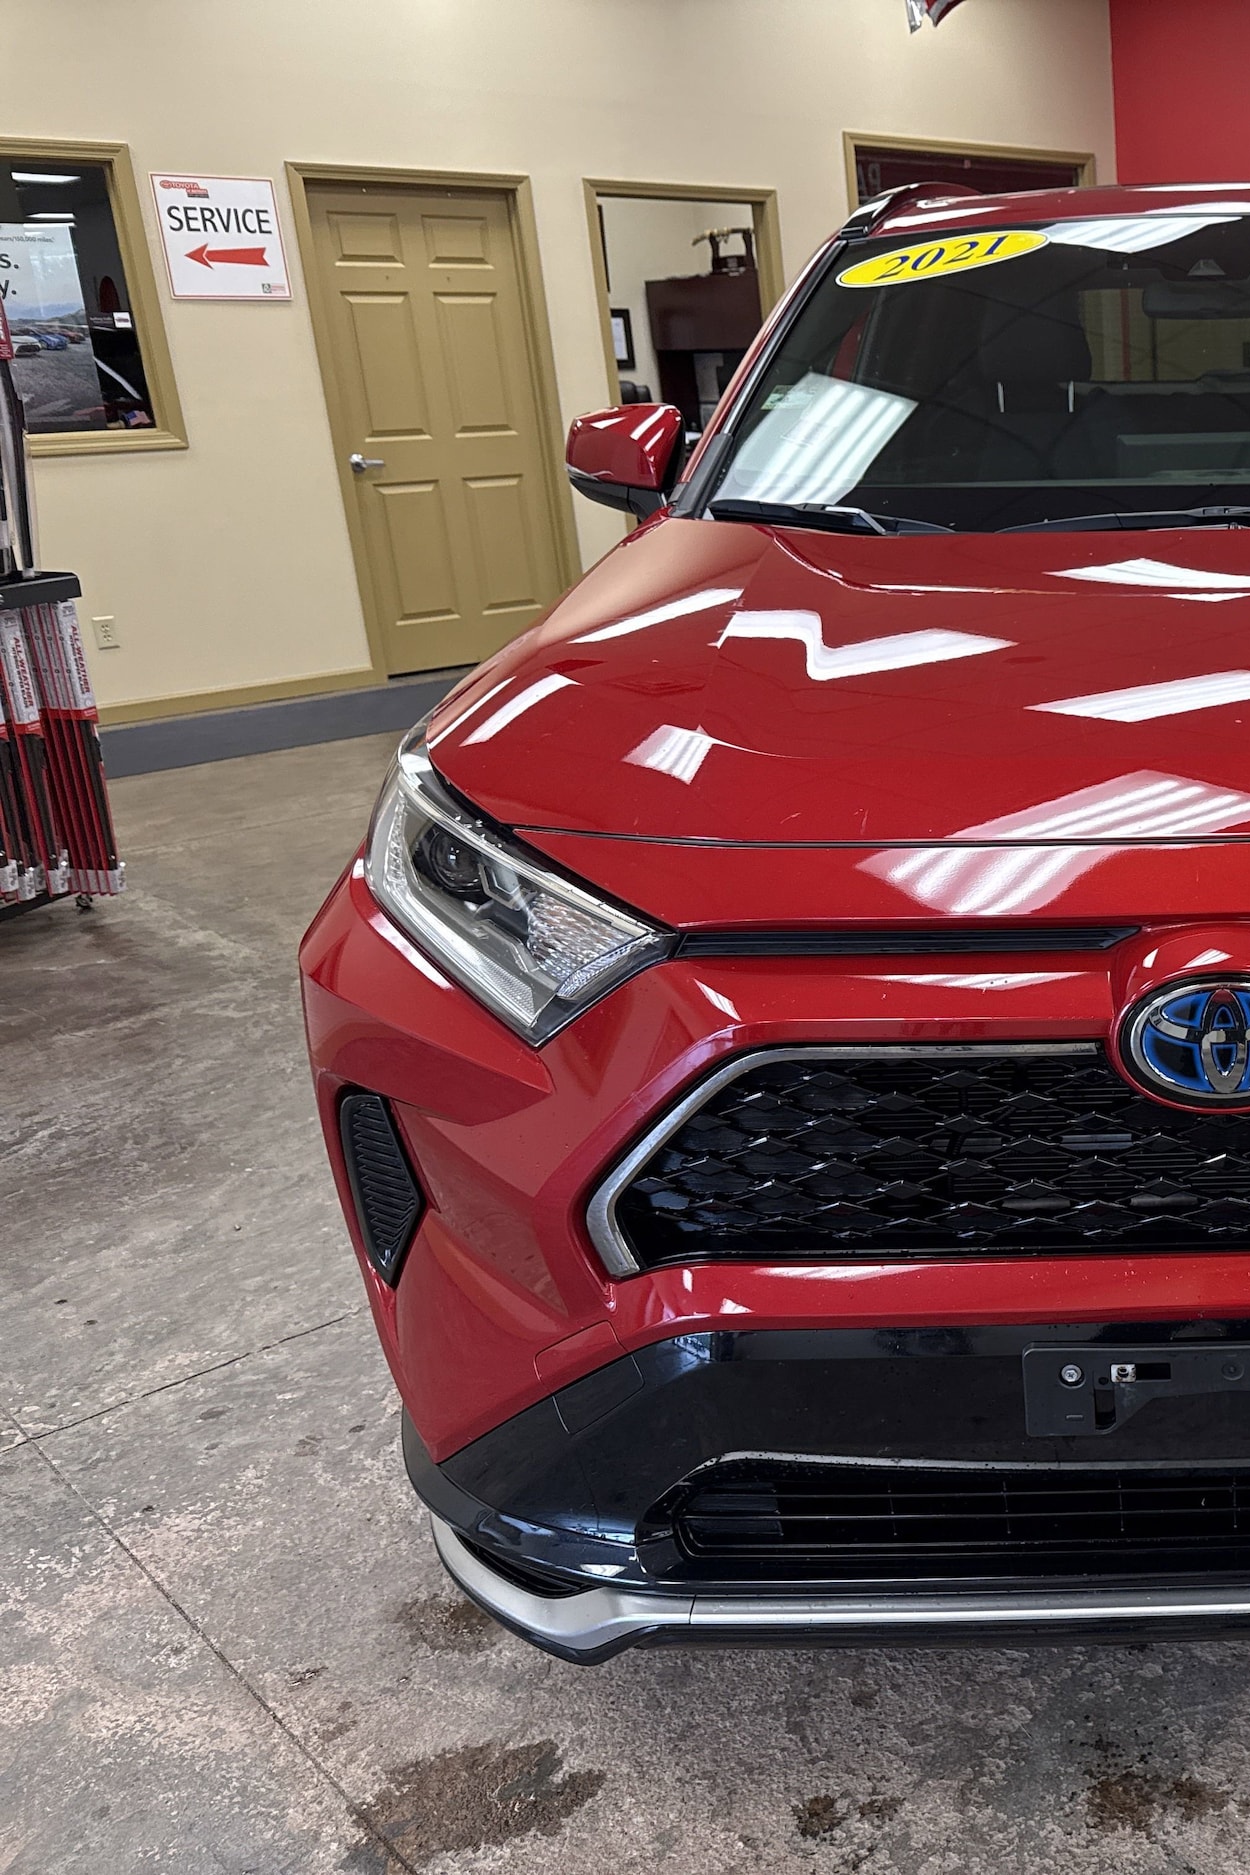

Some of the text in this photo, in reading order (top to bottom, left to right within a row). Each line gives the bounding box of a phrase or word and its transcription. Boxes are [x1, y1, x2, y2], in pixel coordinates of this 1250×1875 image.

[167, 205, 272, 234] SERVICE
[873, 234, 1009, 281] 2021
[13, 636, 34, 708] ALL-WEATHER
[71, 624, 91, 693] ALL-WEATHER
